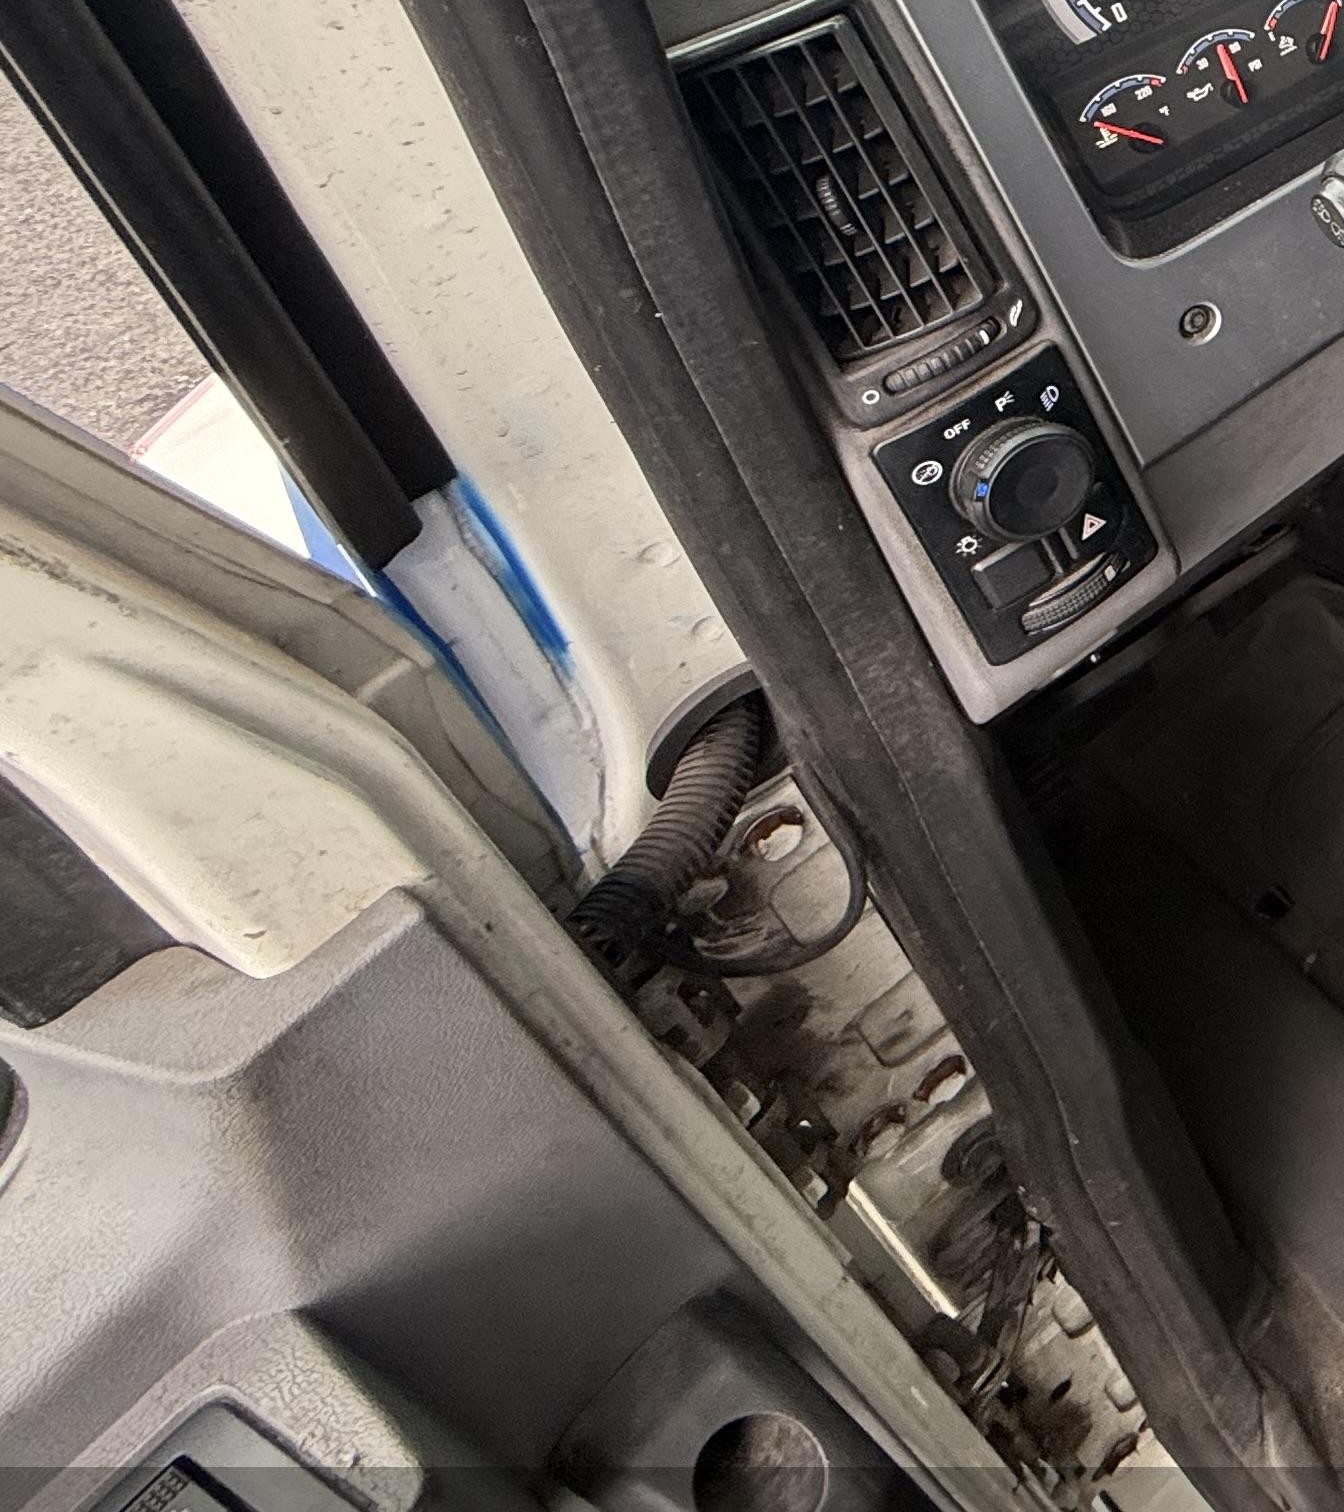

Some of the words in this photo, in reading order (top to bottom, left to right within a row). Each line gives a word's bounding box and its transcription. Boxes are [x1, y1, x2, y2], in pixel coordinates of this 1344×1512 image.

[1110, 2, 1128, 23] 0
[1134, 85, 1153, 101] 220
[943, 418, 971, 440] OFF
